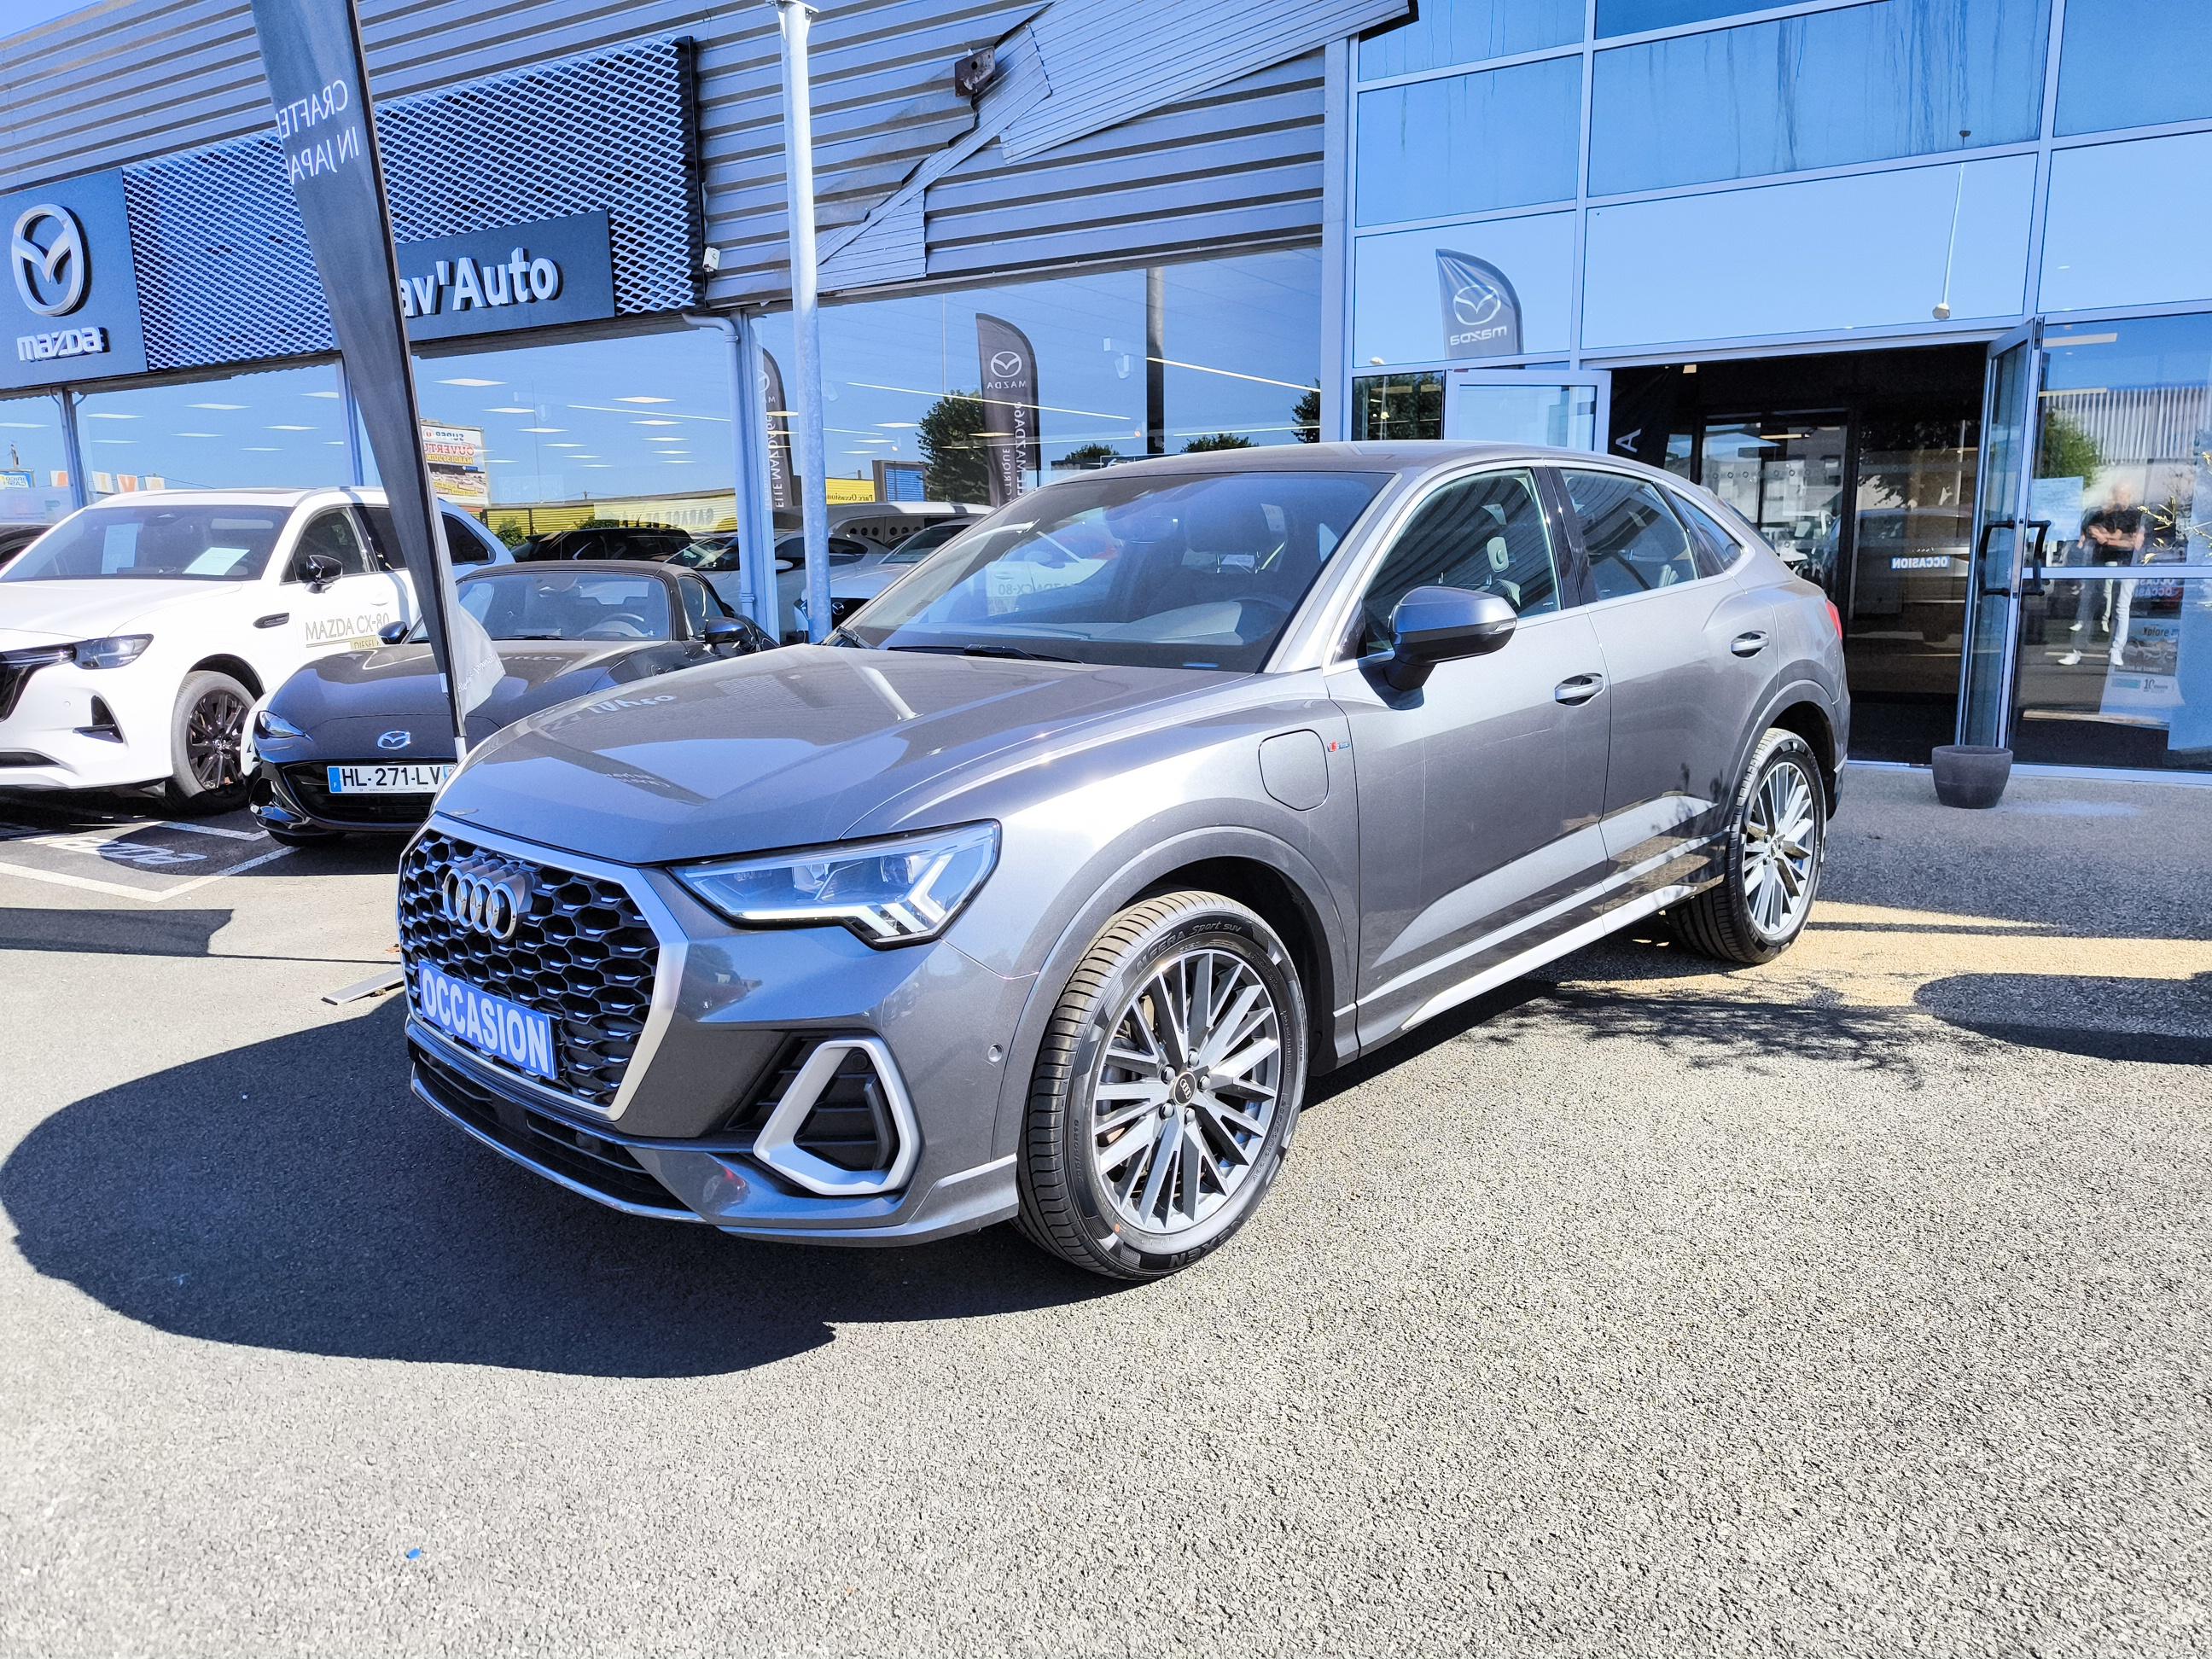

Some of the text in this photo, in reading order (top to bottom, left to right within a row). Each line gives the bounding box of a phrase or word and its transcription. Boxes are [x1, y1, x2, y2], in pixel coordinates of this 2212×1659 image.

[306, 612, 390, 640] MAZDA CX-80
[341, 766, 440, 787] HL-271-LV
[1189, 921, 1221, 935] Sport
[422, 969, 549, 1074] OCCASION
